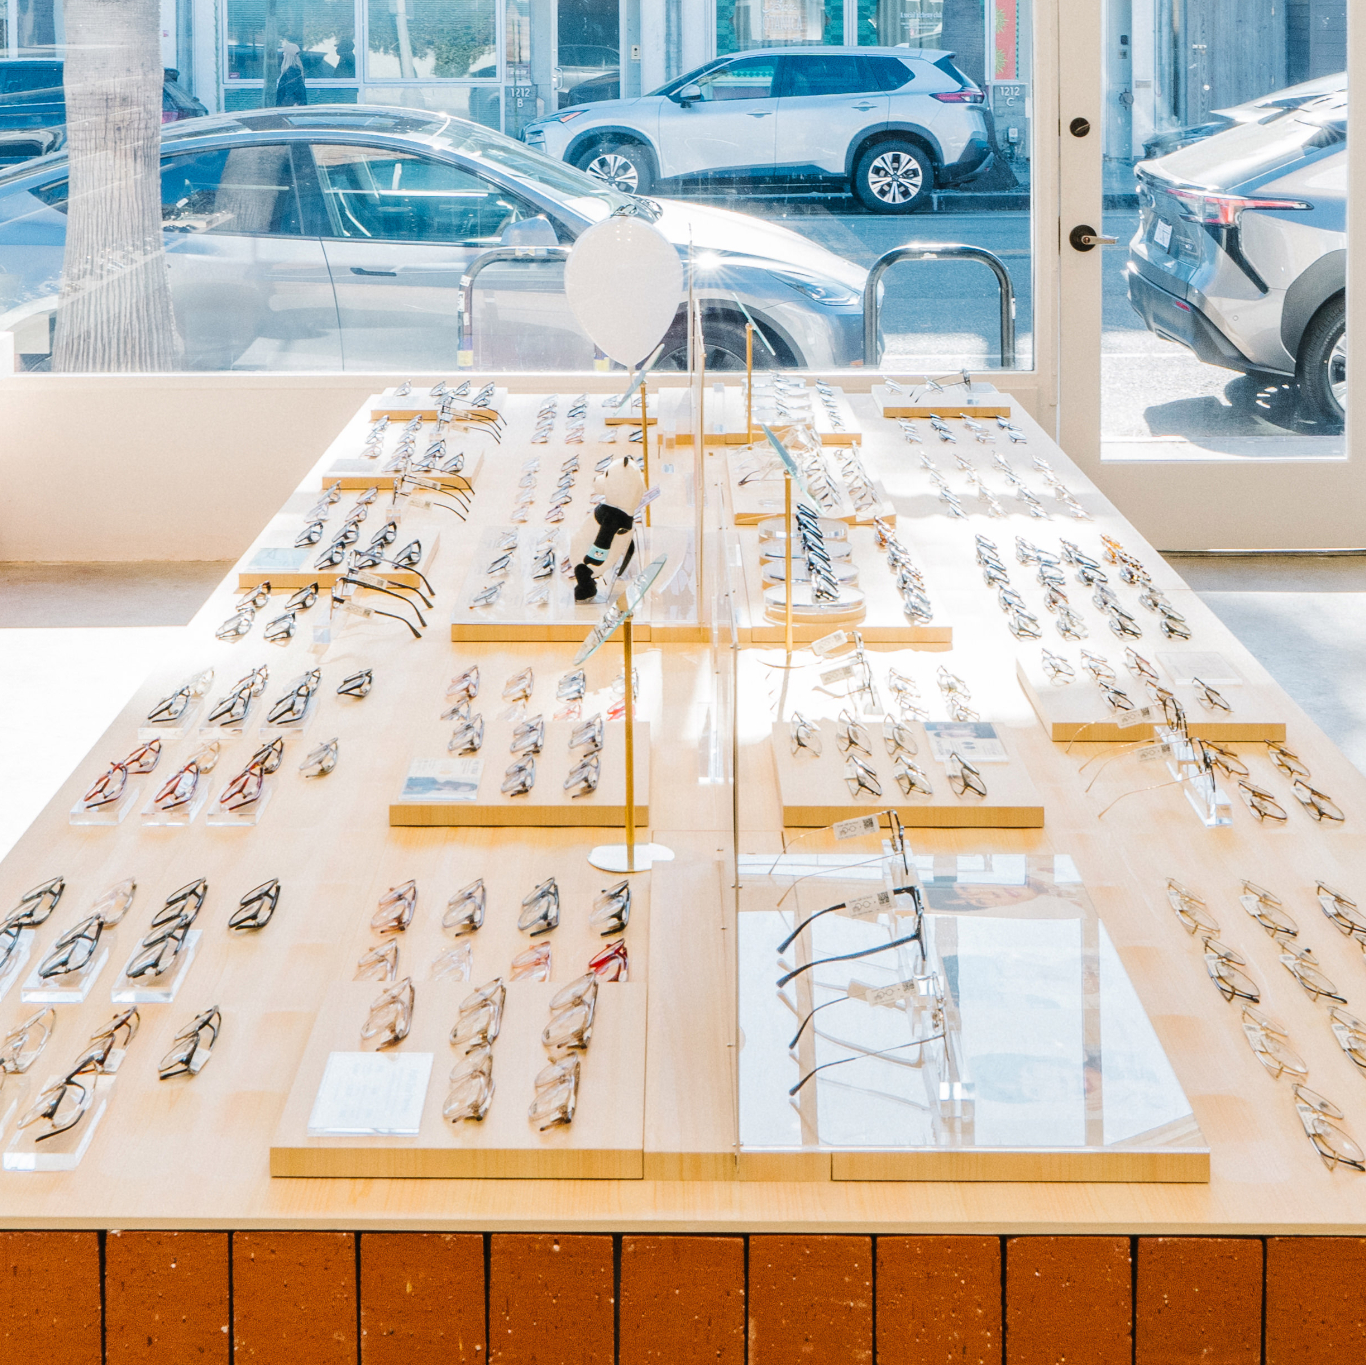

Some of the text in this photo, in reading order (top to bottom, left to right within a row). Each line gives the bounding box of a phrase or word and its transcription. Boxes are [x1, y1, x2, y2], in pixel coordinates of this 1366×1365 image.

[511, 88, 531, 98] 1212
[999, 86, 1020, 96] 1212
[517, 98, 524, 108] B
[1006, 97, 1015, 107] C
